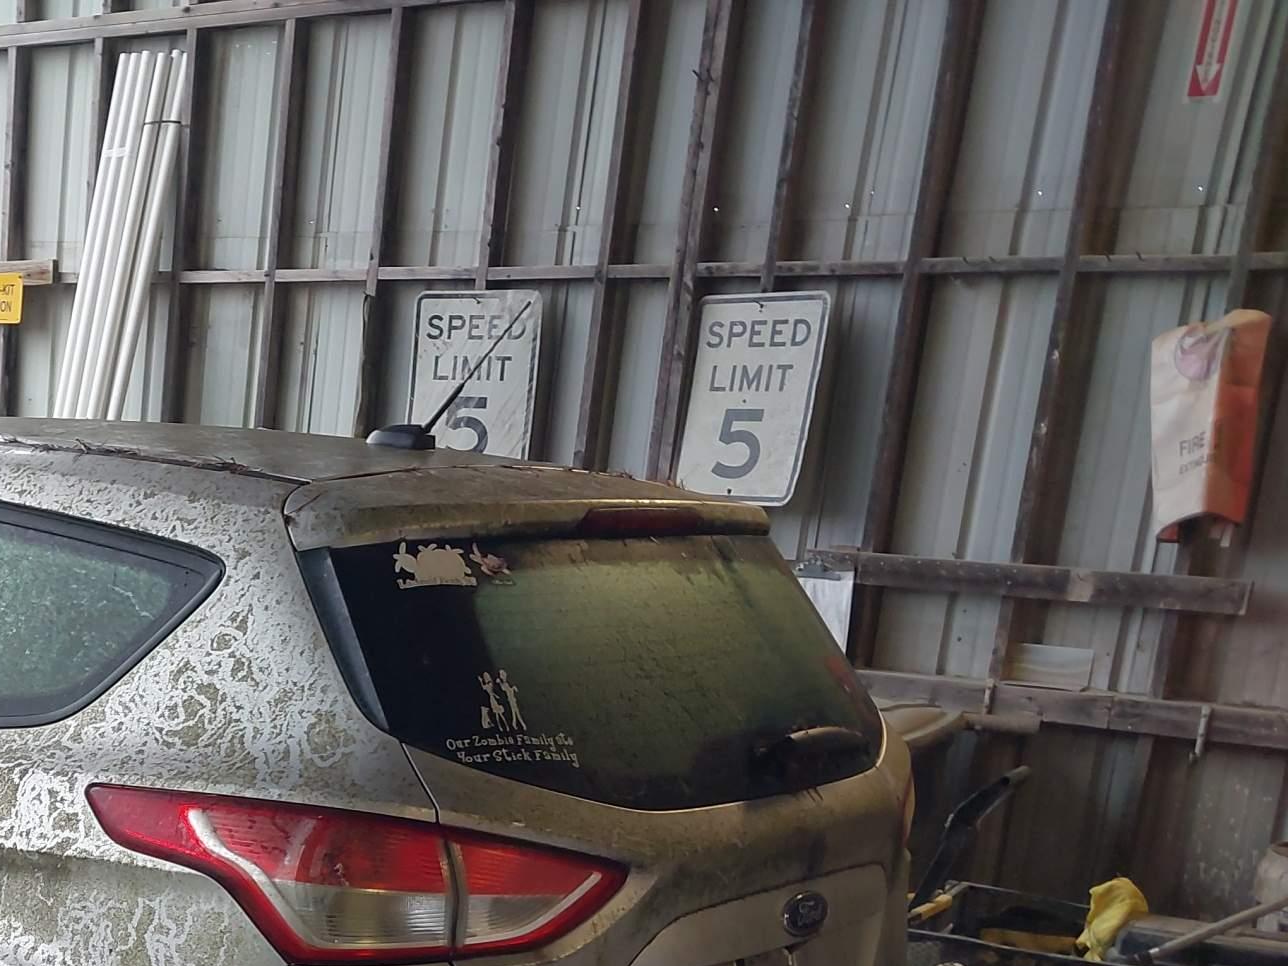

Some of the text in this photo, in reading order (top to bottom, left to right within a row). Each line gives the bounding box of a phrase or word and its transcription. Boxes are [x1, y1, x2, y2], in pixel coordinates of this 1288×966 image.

[426, 314, 527, 340] SPEED
[706, 318, 812, 348] SPEED
[432, 355, 512, 382] LIMIT
[709, 364, 794, 393] LIMIT
[445, 396, 488, 454] 5
[711, 408, 765, 479] 5
[1178, 431, 1207, 457] FIRE
[446, 738, 471, 751] Our
[472, 733, 514, 747] Zombie
[516, 733, 557, 752] Family
[456, 747, 580, 768] Your Stick Family
